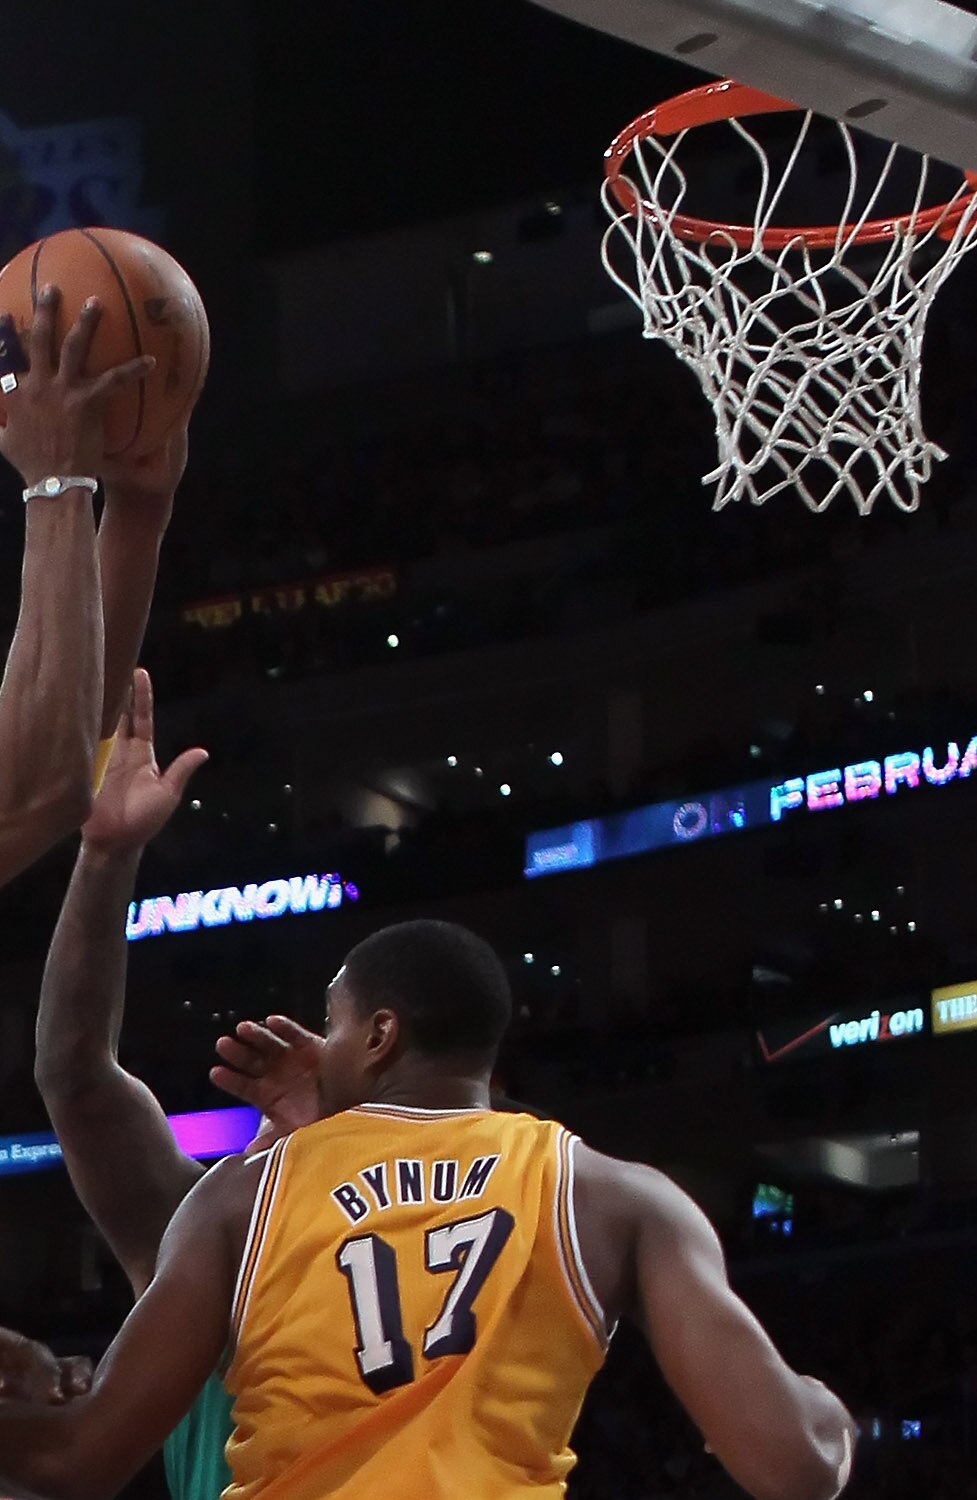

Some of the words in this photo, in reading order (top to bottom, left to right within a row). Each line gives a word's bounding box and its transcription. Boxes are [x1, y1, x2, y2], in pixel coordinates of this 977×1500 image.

[829, 1008, 923, 1048] verizon
[330, 1153, 502, 1227] BYNUM
[335, 1206, 515, 1395] 17
